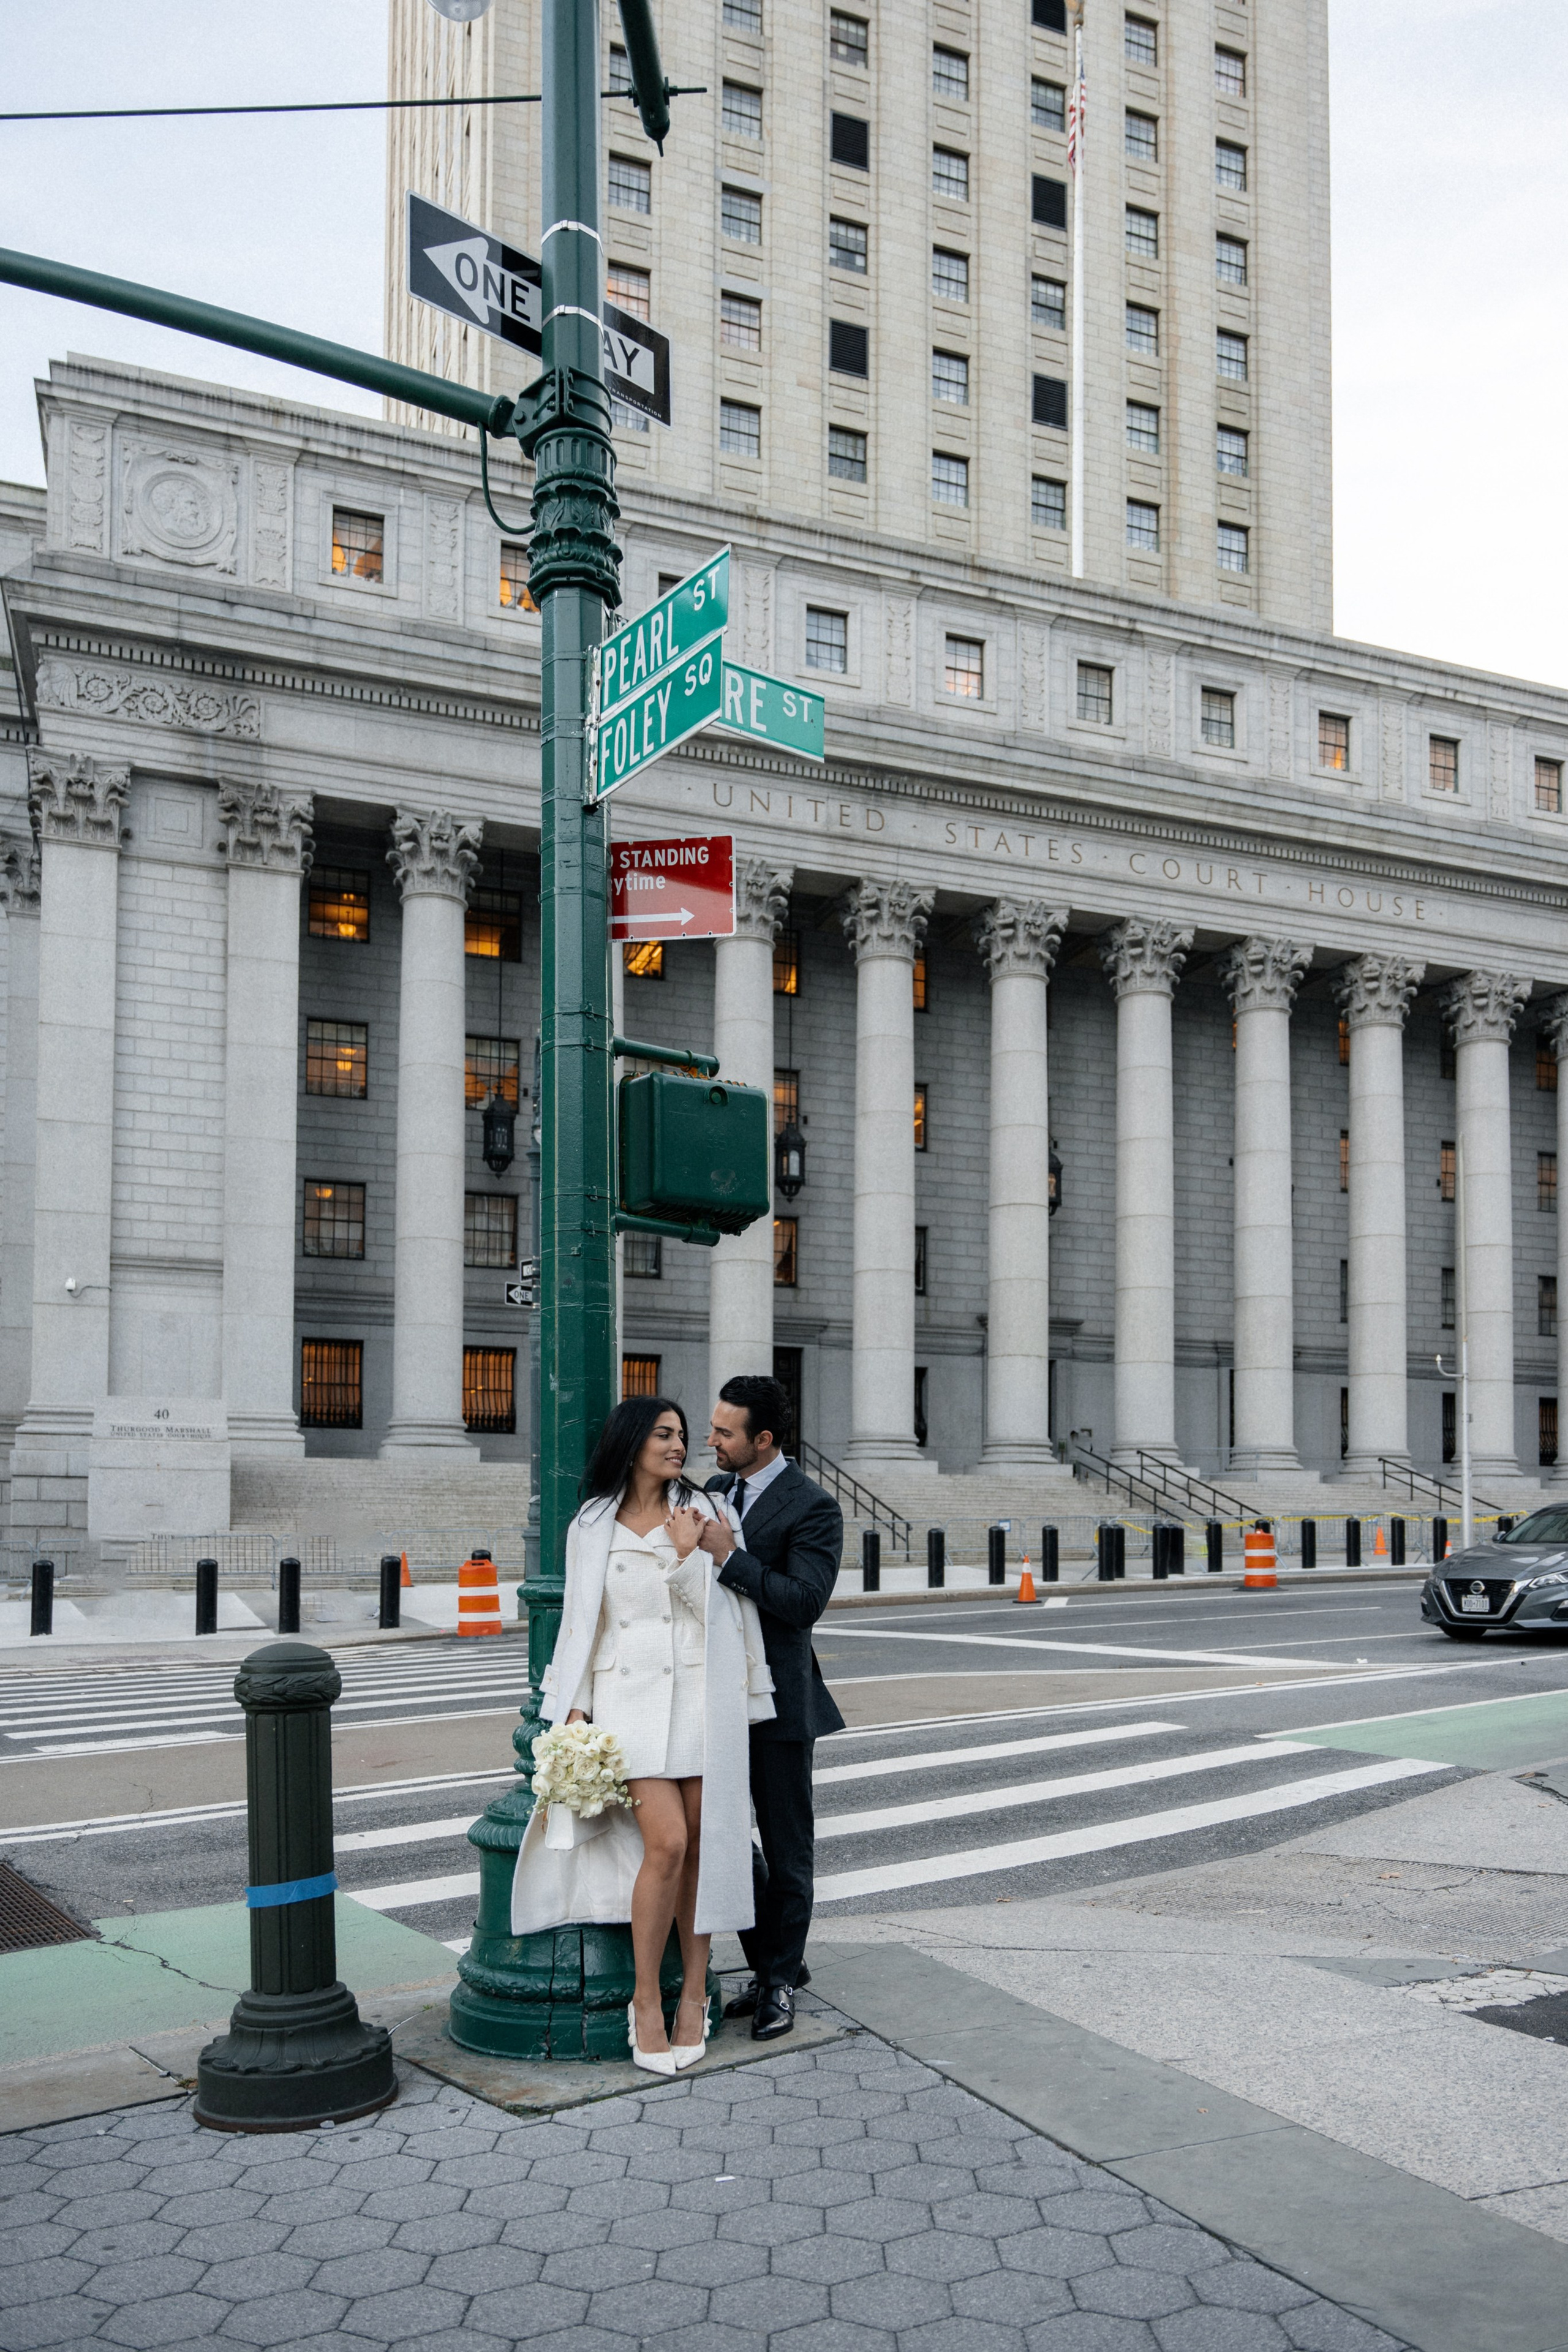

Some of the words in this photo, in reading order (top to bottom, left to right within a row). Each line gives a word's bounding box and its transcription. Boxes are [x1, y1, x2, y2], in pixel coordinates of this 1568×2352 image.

[455, 252, 530, 323] ONE
[603, 329, 640, 377] AY
[608, 386, 662, 418] TRANSPORTATION
[603, 601, 679, 706] PEARL
[693, 565, 720, 611] ST
[600, 680, 672, 787] FOLEY
[684, 652, 713, 696] SQ
[725, 668, 767, 733] RE
[782, 690, 812, 723] ST
[620, 846, 709, 869] STANDING
[713, 783, 885, 832] UNITED
[945, 823, 1083, 864] STATES
[1129, 853, 1267, 894] COURT
[1308, 881, 1425, 920] HOUSE
[613, 873, 666, 895] ytime
[514, 1291, 529, 1300] ONE
[154, 1409, 170, 1420] 40
